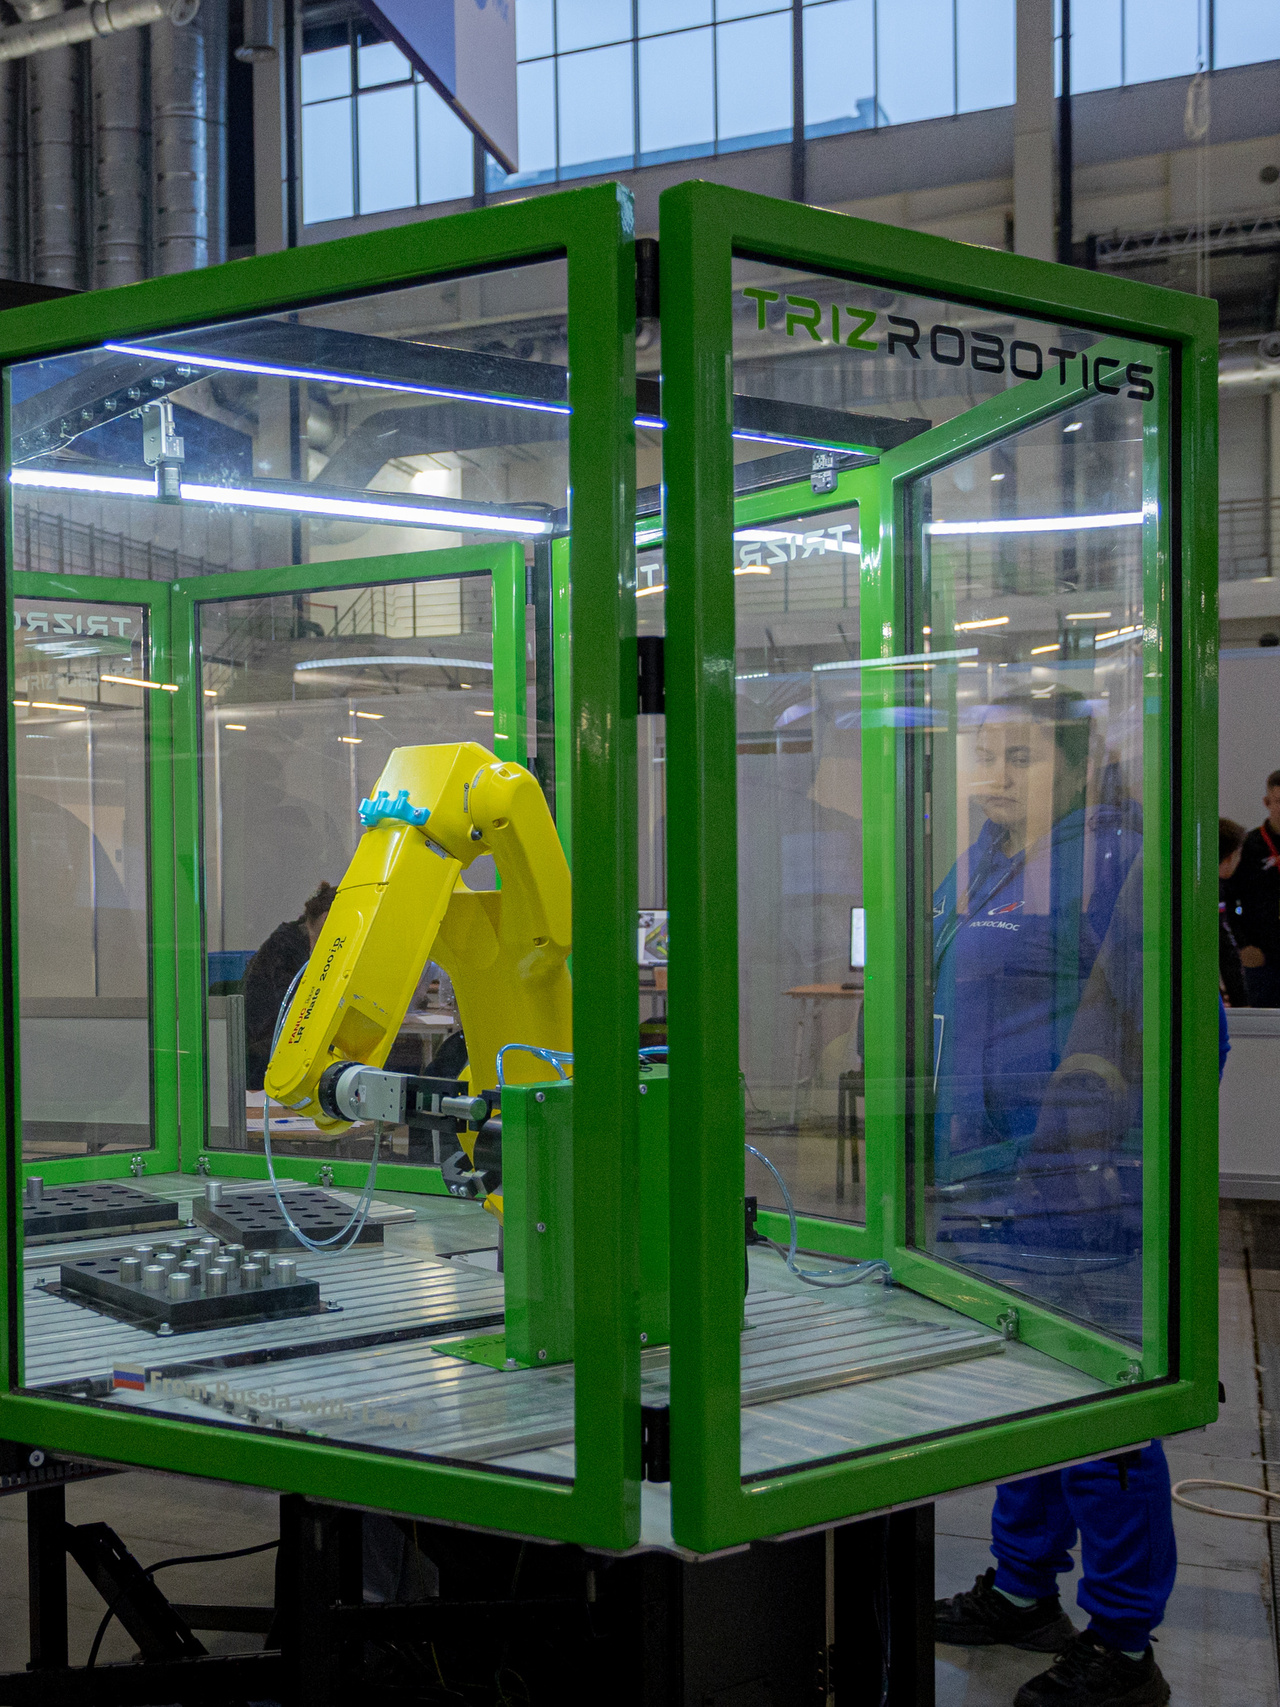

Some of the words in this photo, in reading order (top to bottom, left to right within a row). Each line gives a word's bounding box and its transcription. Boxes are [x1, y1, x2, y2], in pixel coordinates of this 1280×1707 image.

[742, 287, 1155, 402] TRIZROBOTICS
[288, 1008, 306, 1044] FANUC
[294, 1026, 305, 1044] LR
[304, 988, 320, 1020] Mate
[151, 1371, 207, 1400] From
[216, 1380, 291, 1411] Russia
[299, 1396, 352, 1421] with
